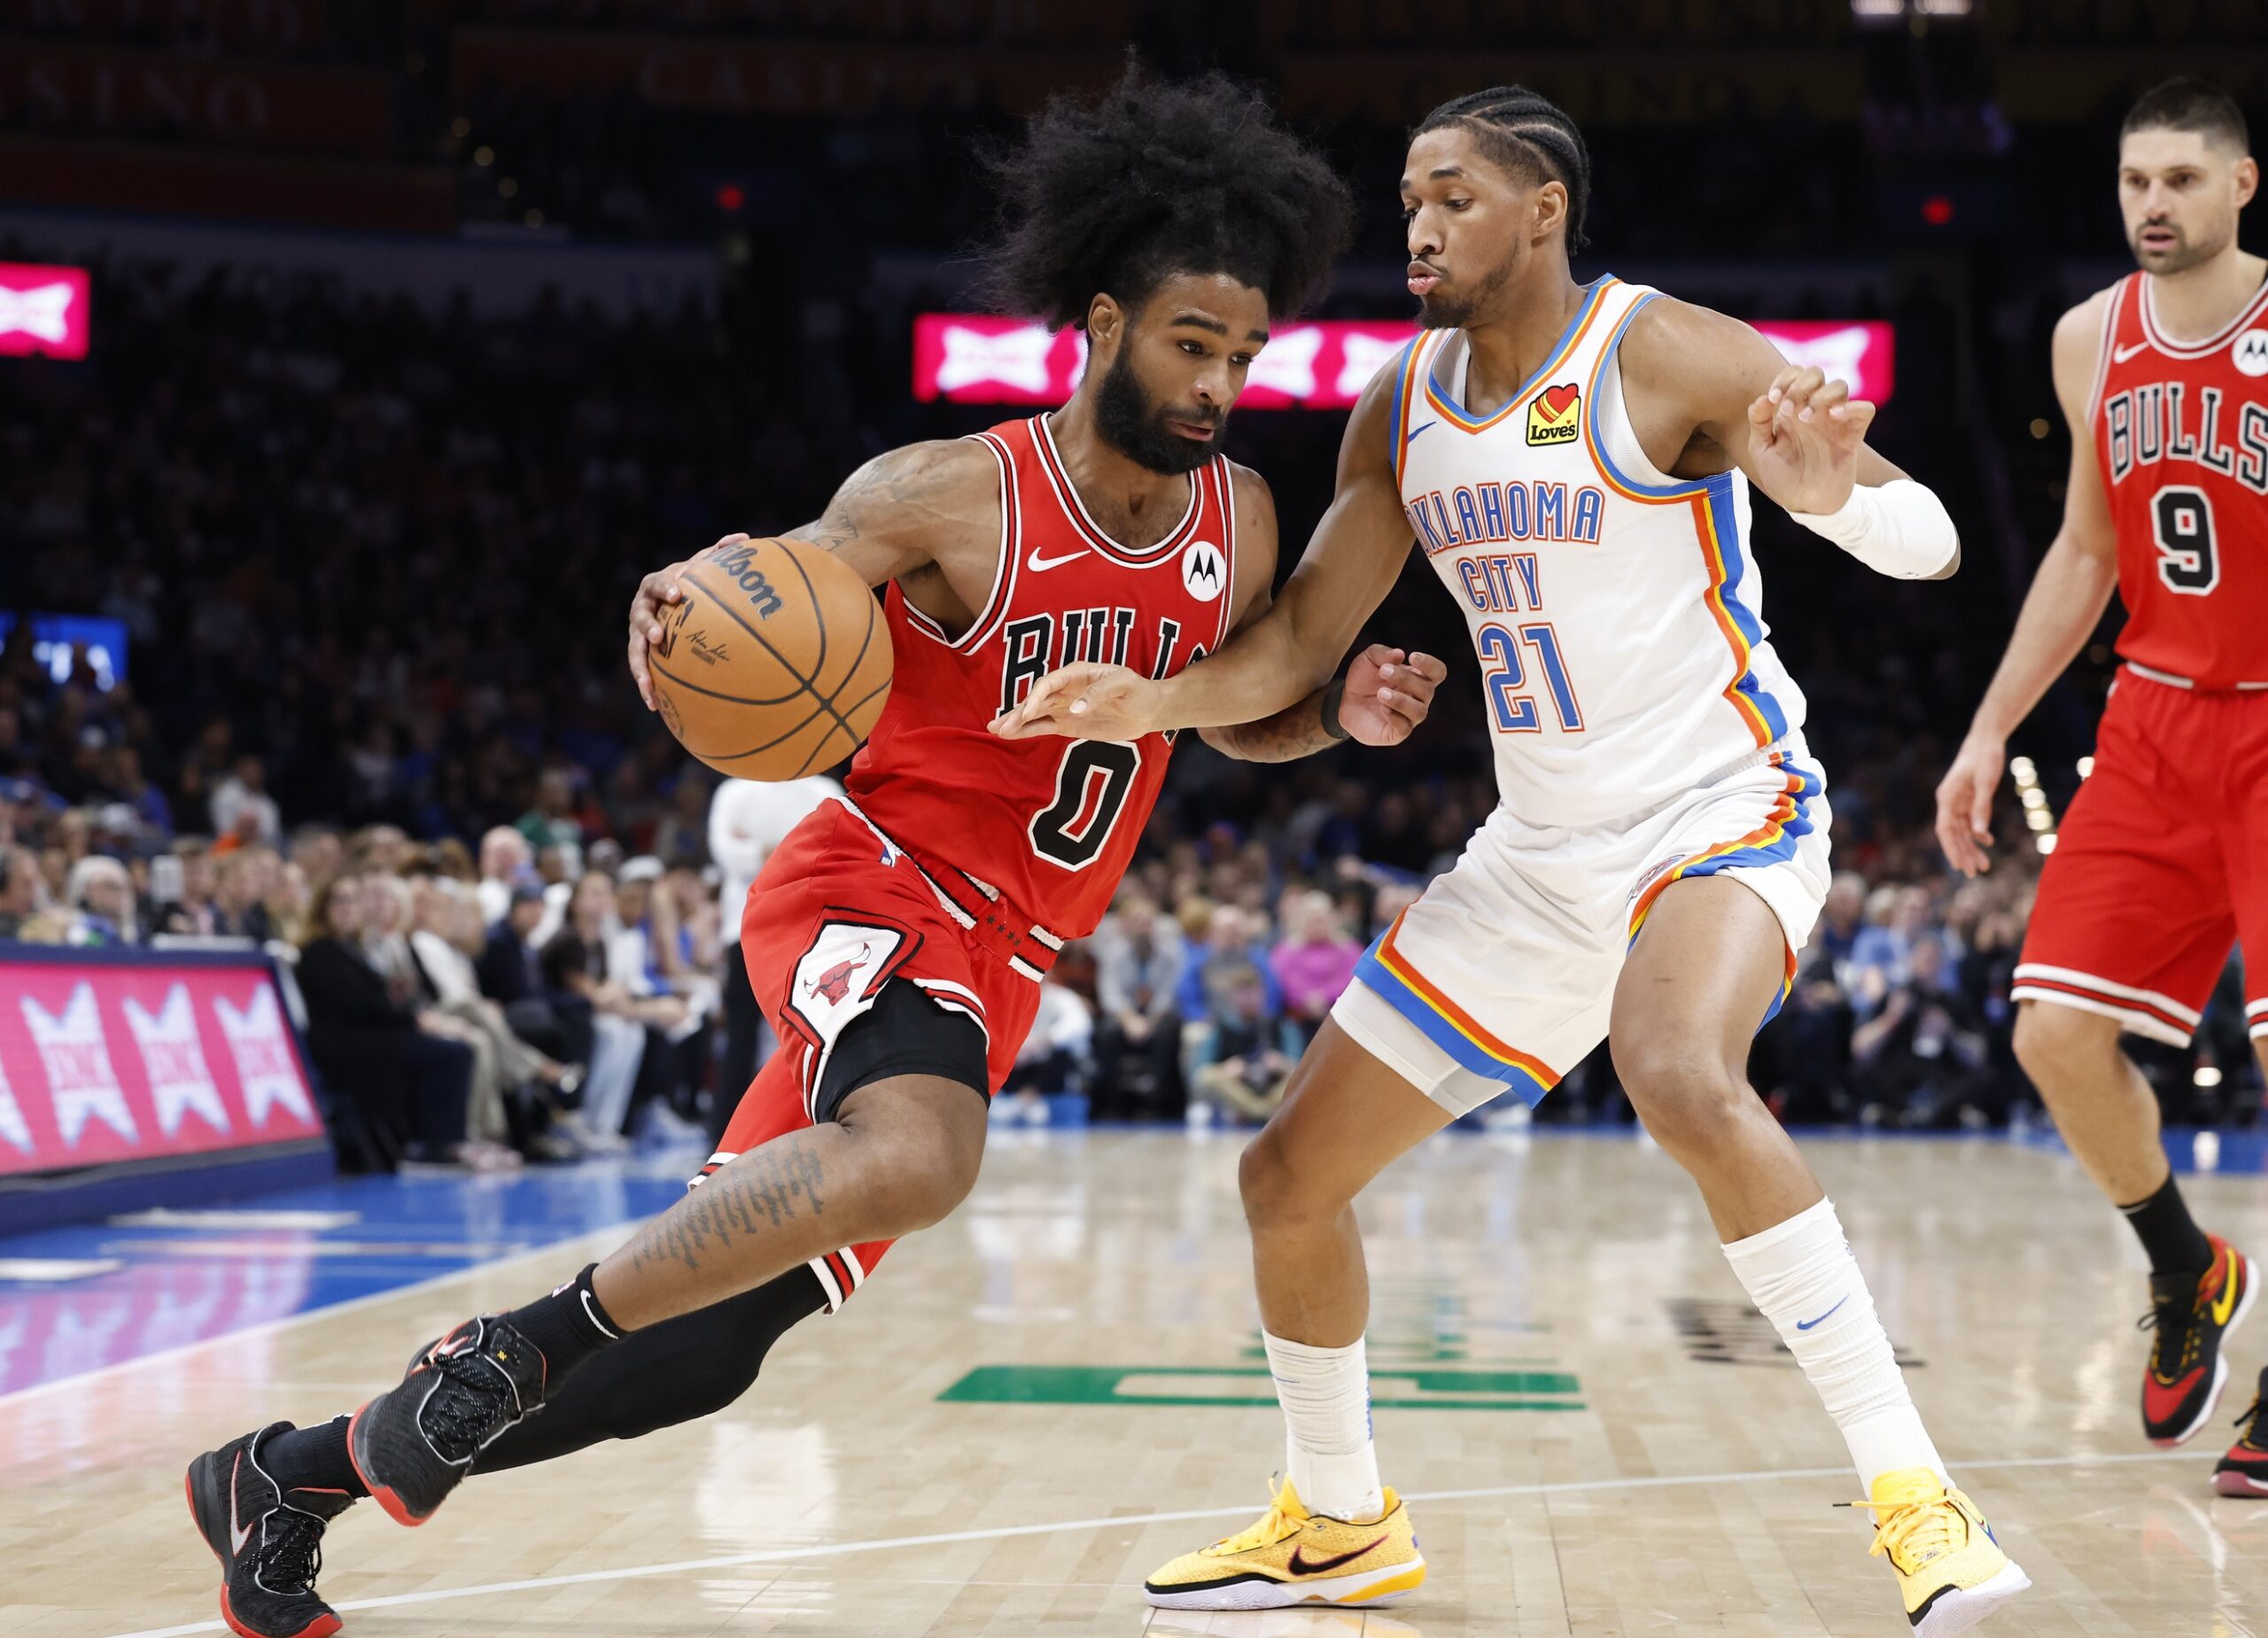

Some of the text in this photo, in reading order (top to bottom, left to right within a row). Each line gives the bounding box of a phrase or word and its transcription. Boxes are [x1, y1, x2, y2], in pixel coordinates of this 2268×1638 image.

[2105, 382, 2268, 496] BULLS
[1456, 553, 1542, 612] CITY
[2150, 485, 2221, 596] 9
[995, 607, 1210, 747] BULL
[1477, 623, 1585, 734] 21
[1028, 737, 1142, 873] 0
